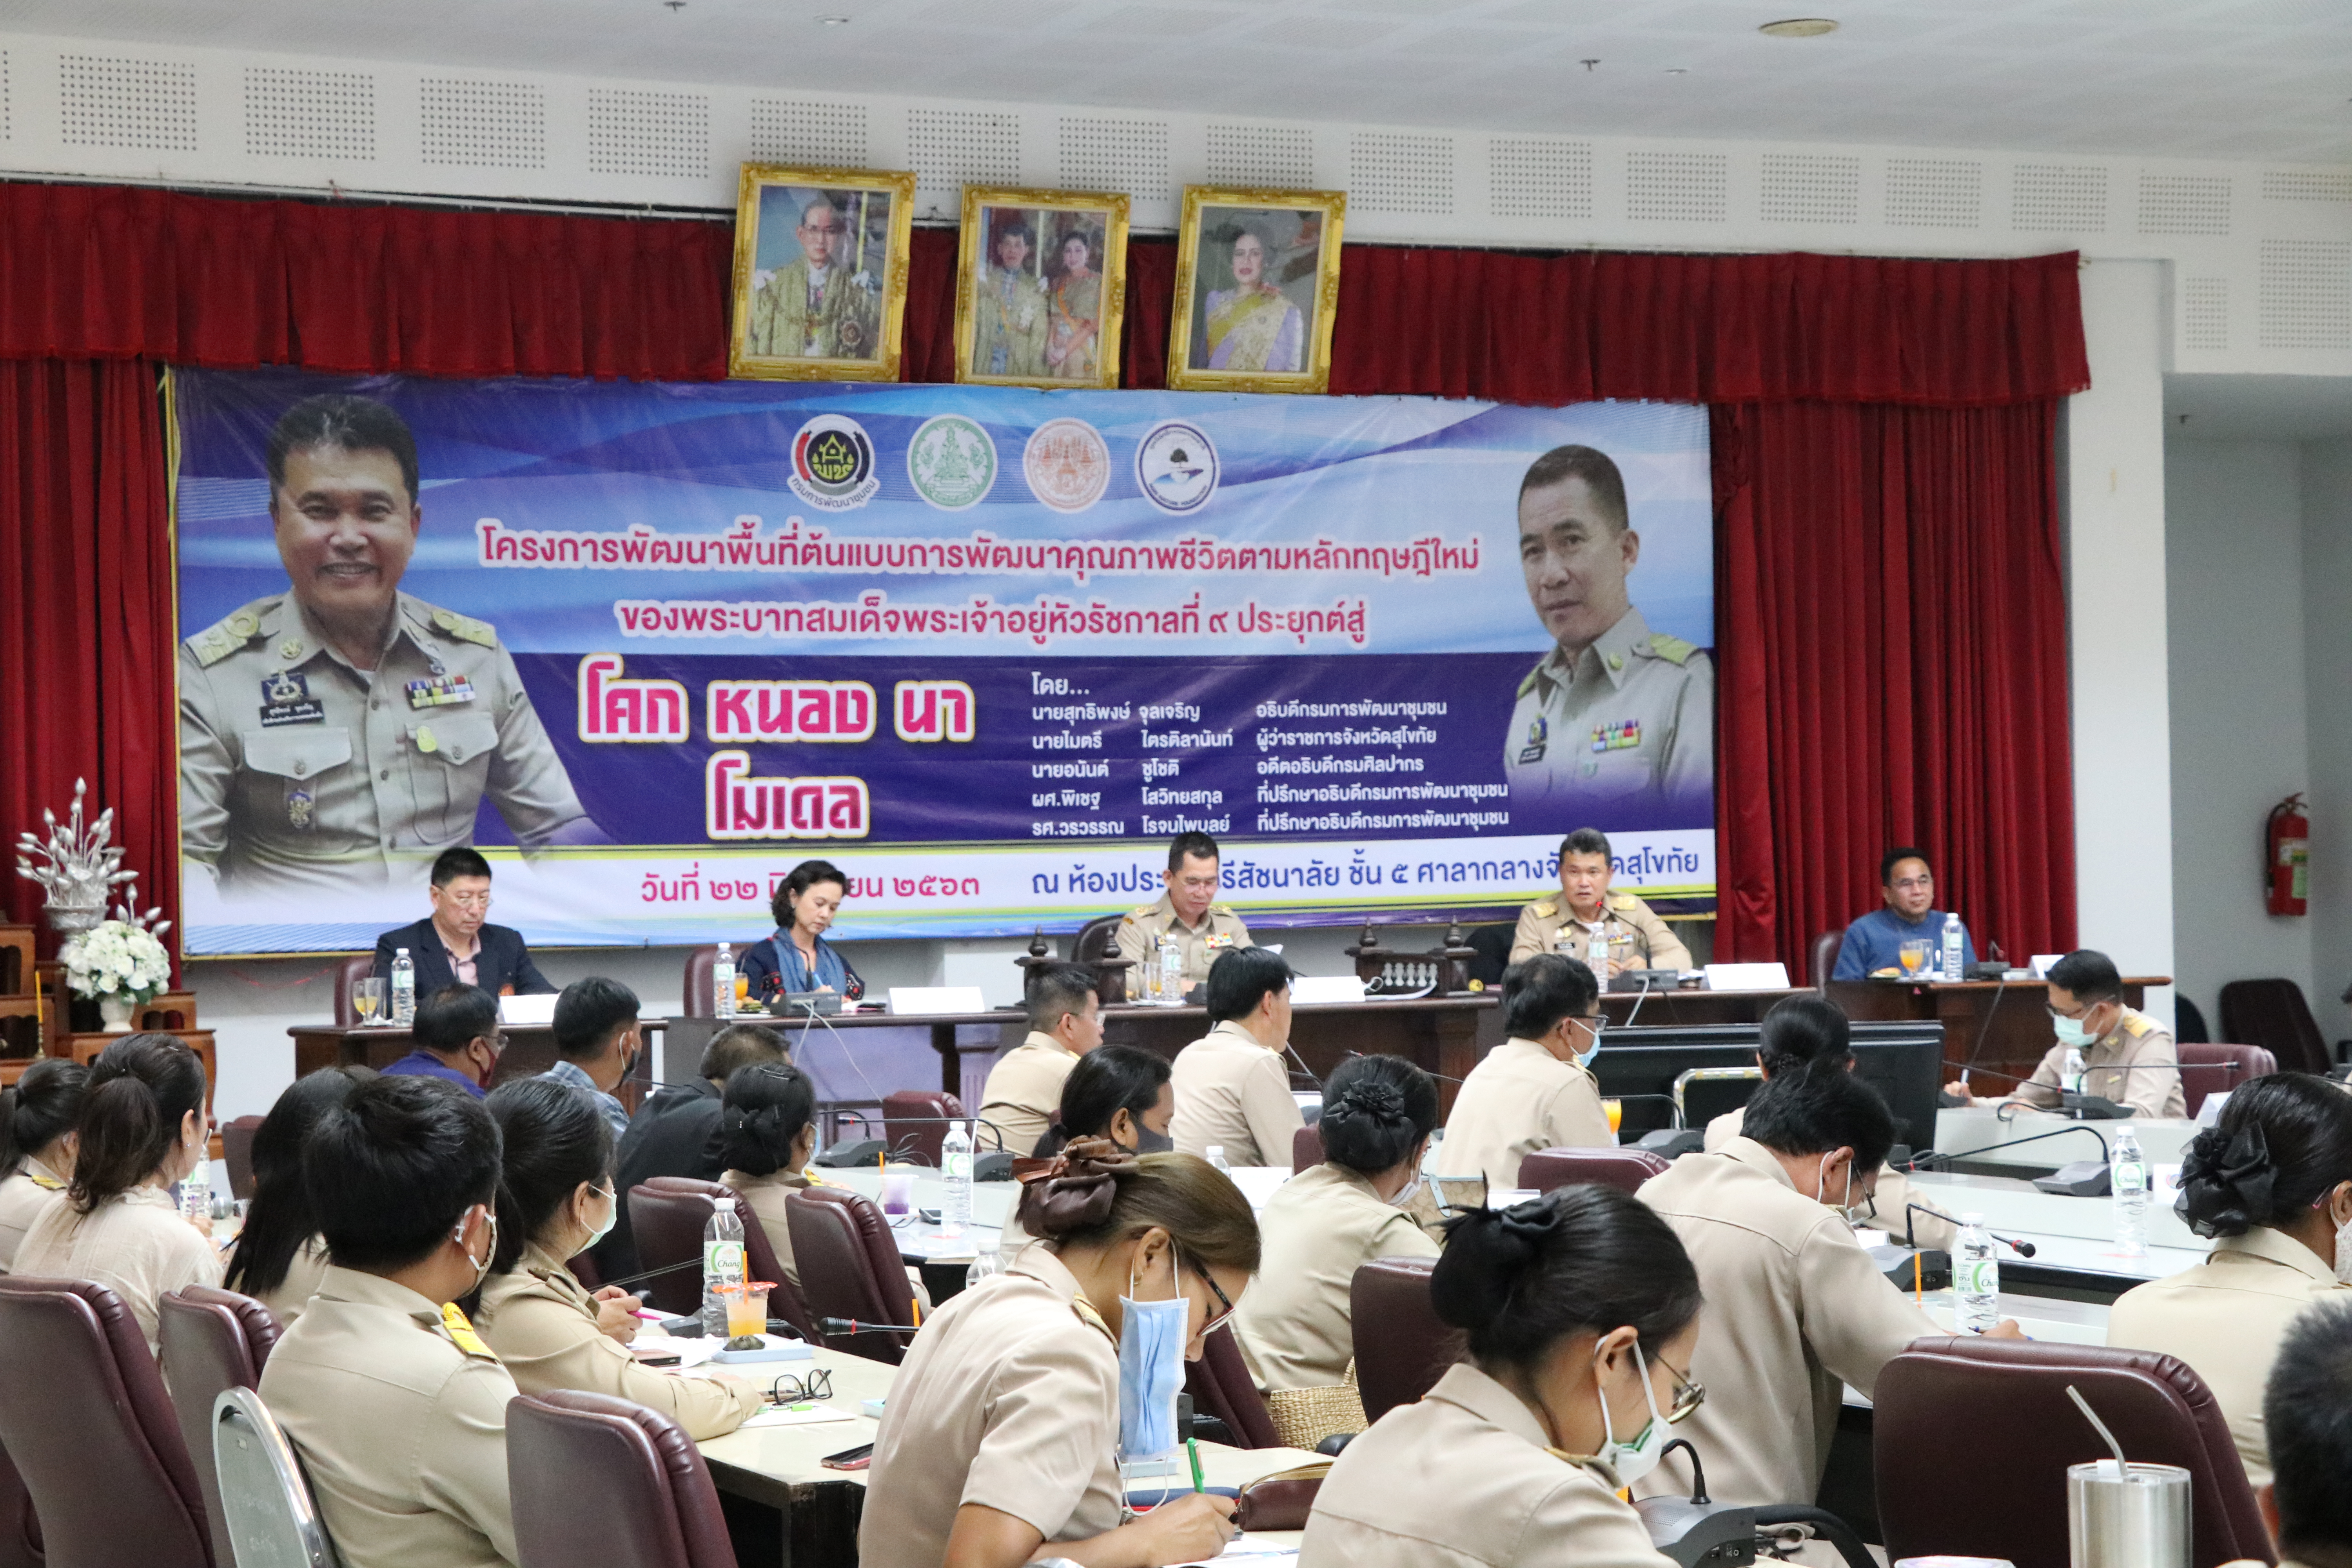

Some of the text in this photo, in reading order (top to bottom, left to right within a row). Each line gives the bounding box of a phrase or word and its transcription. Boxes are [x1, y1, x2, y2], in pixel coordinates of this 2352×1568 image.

[483, 522, 1479, 580] โครงการพัฒนาพื้นที่ต้นแบบการพัฒนาคุณภาพชีวิตตามหลักทฤษฎีใหม่
[621, 593, 1365, 645] ของพระบาทสมเด็จพระเจ้าอยู่หัวรัชกาลที่ ๙ ประยุกต์สู่
[587, 661, 967, 734] โคก หนอง นา
[1031, 671, 1089, 695] โดย...
[1033, 699, 1446, 726] นายสุทธิพงษ์ จุลเจริญ อธิบดีกรมการพัฒนาชุมชน
[1033, 725, 1437, 752] นายไมตรี ไตรติลานันท์ ผู้ว่าราชการจังหวัดสุโขทัย
[1032, 754, 1424, 782] นายอนันต์ ชูโชติ อดีตอธิบดีกรมศิลปากร
[715, 759, 862, 831] โมเดล
[1032, 779, 1508, 810] ผศ.พิเชฐ โสวิทยสกุล ที่ปรึกษาอธิบดีกรมการพัฒนาชุมชน
[1033, 808, 1509, 836] รศ.วรวรรณ โรจนไพบลย์ ที่ปรึกษาอธิบดีกรมการพัฒนาชุมชน
[642, 862, 700, 902] วันที่
[709, 880, 758, 901] ๒๒
[893, 875, 980, 897] ๒๕๖๓
[1032, 873, 1059, 894] ณ
[1348, 849, 1382, 886] ชั้น
[1391, 864, 1408, 884] ๕
[717, 1260, 740, 1268] Chang
